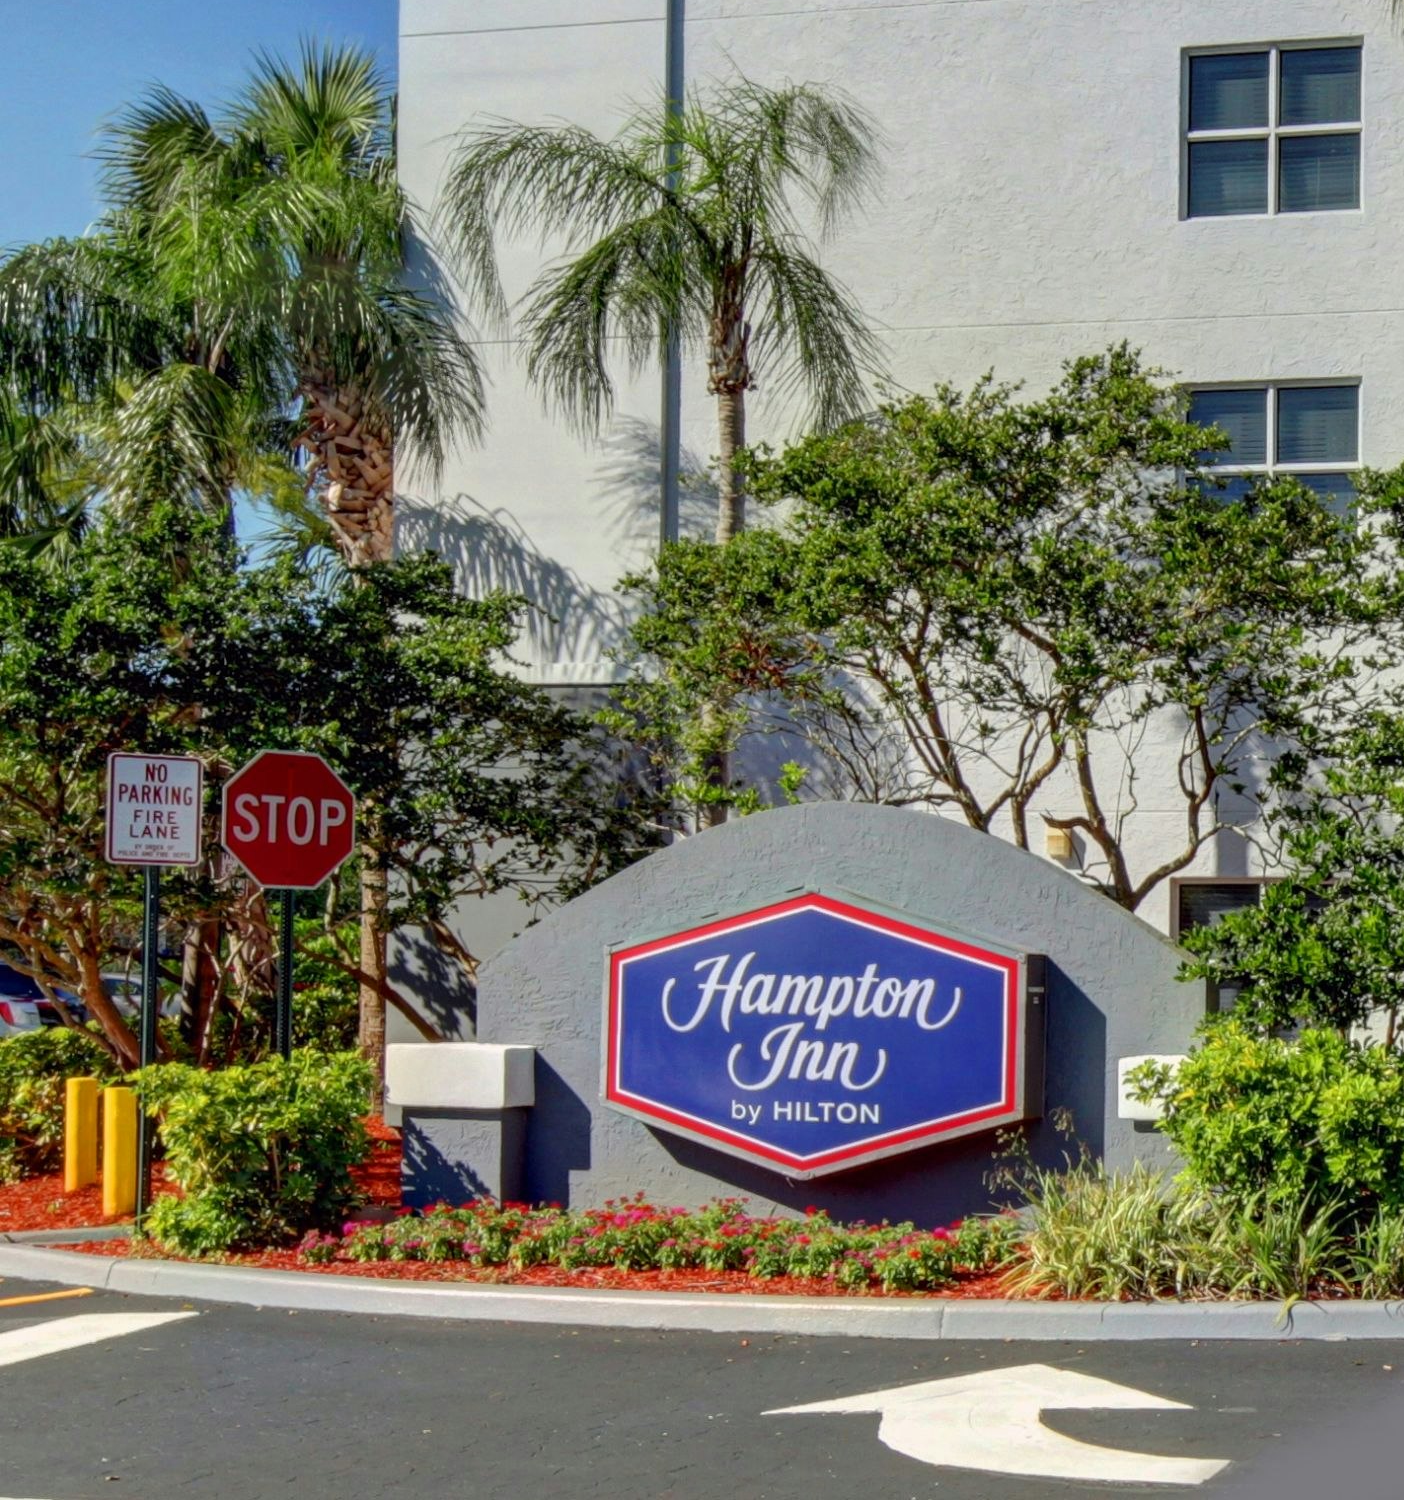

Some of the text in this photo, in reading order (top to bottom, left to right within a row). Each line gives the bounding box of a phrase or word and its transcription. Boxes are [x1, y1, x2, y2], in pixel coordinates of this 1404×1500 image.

[145, 763, 168, 783] NO
[118, 783, 193, 806] PARKING
[133, 809, 177, 825] FIRE
[232, 793, 347, 846] STOP
[129, 824, 180, 840] LANE
[661, 951, 962, 1033] Hampton
[726, 1021, 887, 1092] Inn
[730, 1099, 881, 1126] by HILTON
